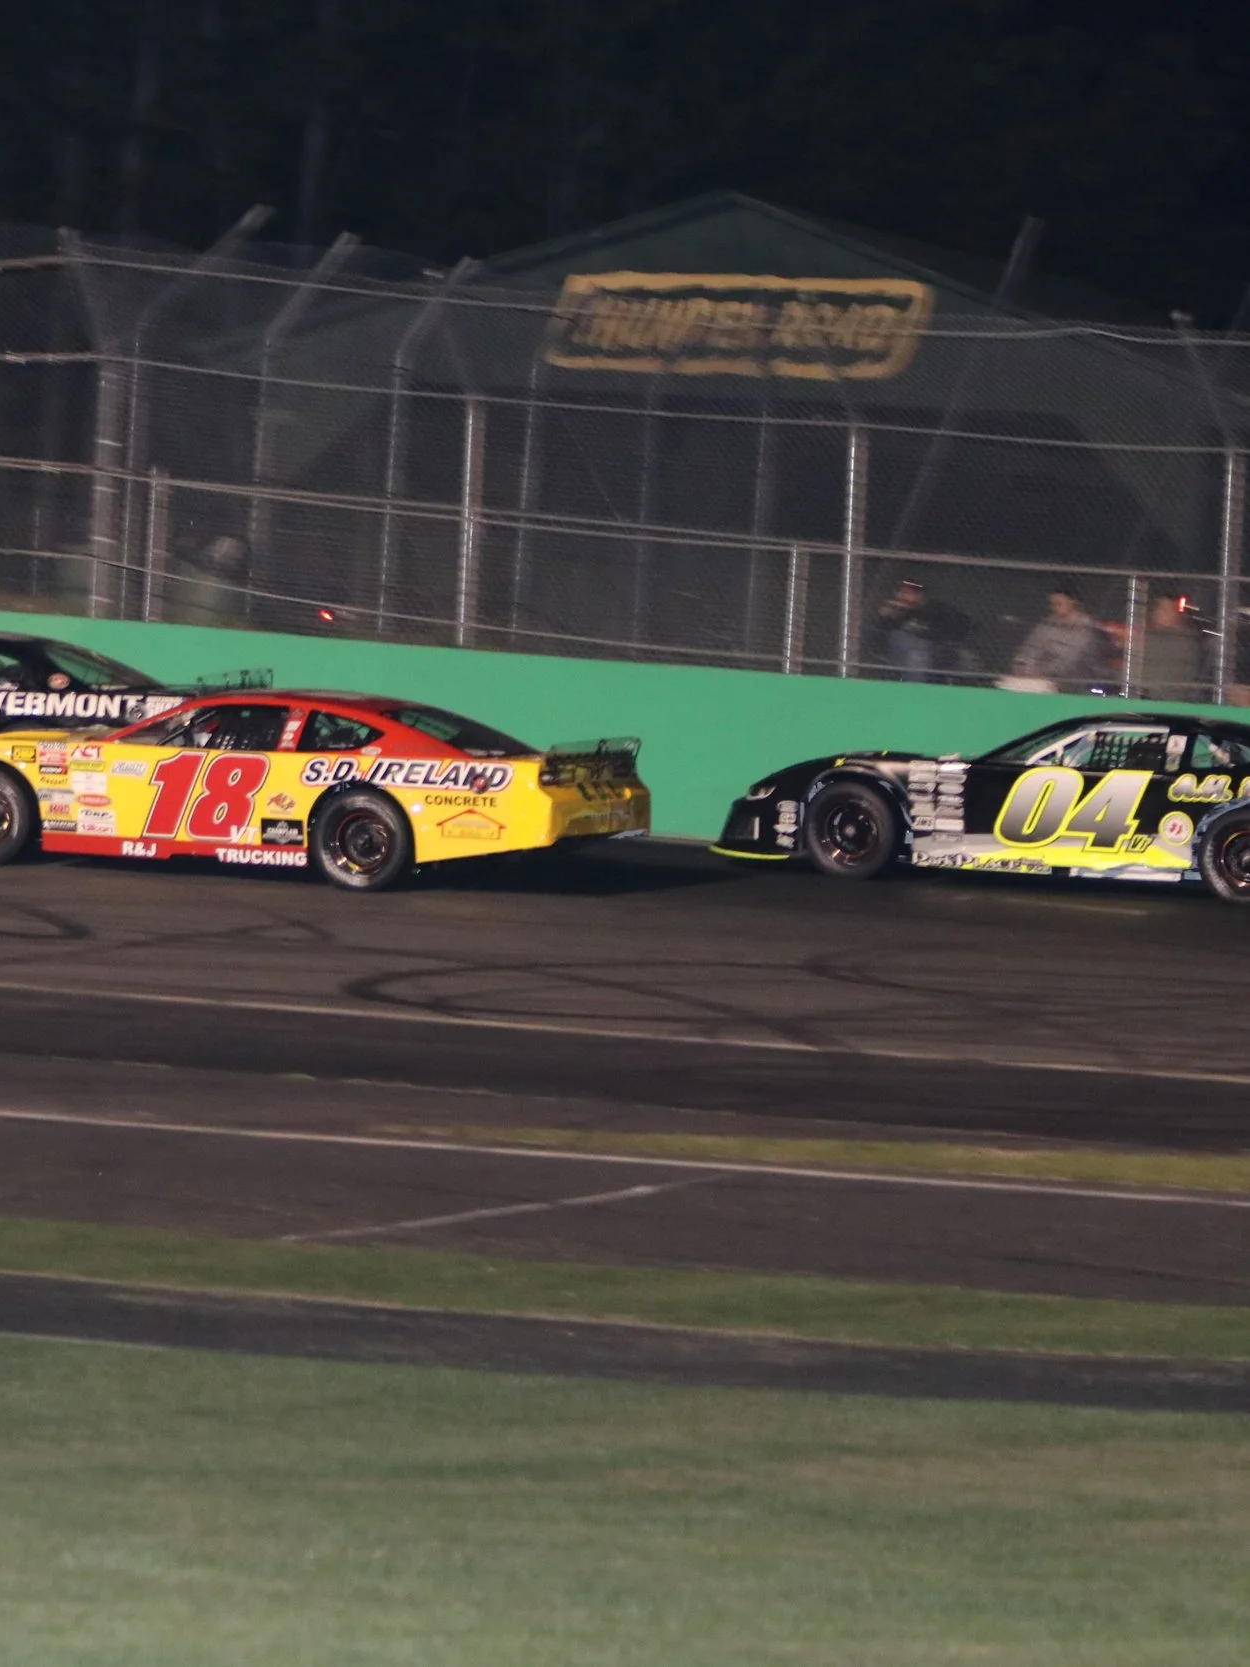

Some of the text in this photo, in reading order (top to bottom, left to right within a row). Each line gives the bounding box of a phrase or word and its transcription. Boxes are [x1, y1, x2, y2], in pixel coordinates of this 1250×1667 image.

[71, 742, 104, 759] ACT
[303, 758, 513, 790] S.D. IRELAND
[143, 751, 270, 840] 18
[424, 794, 498, 808] CONCRETE
[993, 766, 1154, 854] 04
[229, 825, 260, 844] VT
[1125, 833, 1155, 854] VT
[121, 841, 308, 867] R&J TRUCKING
